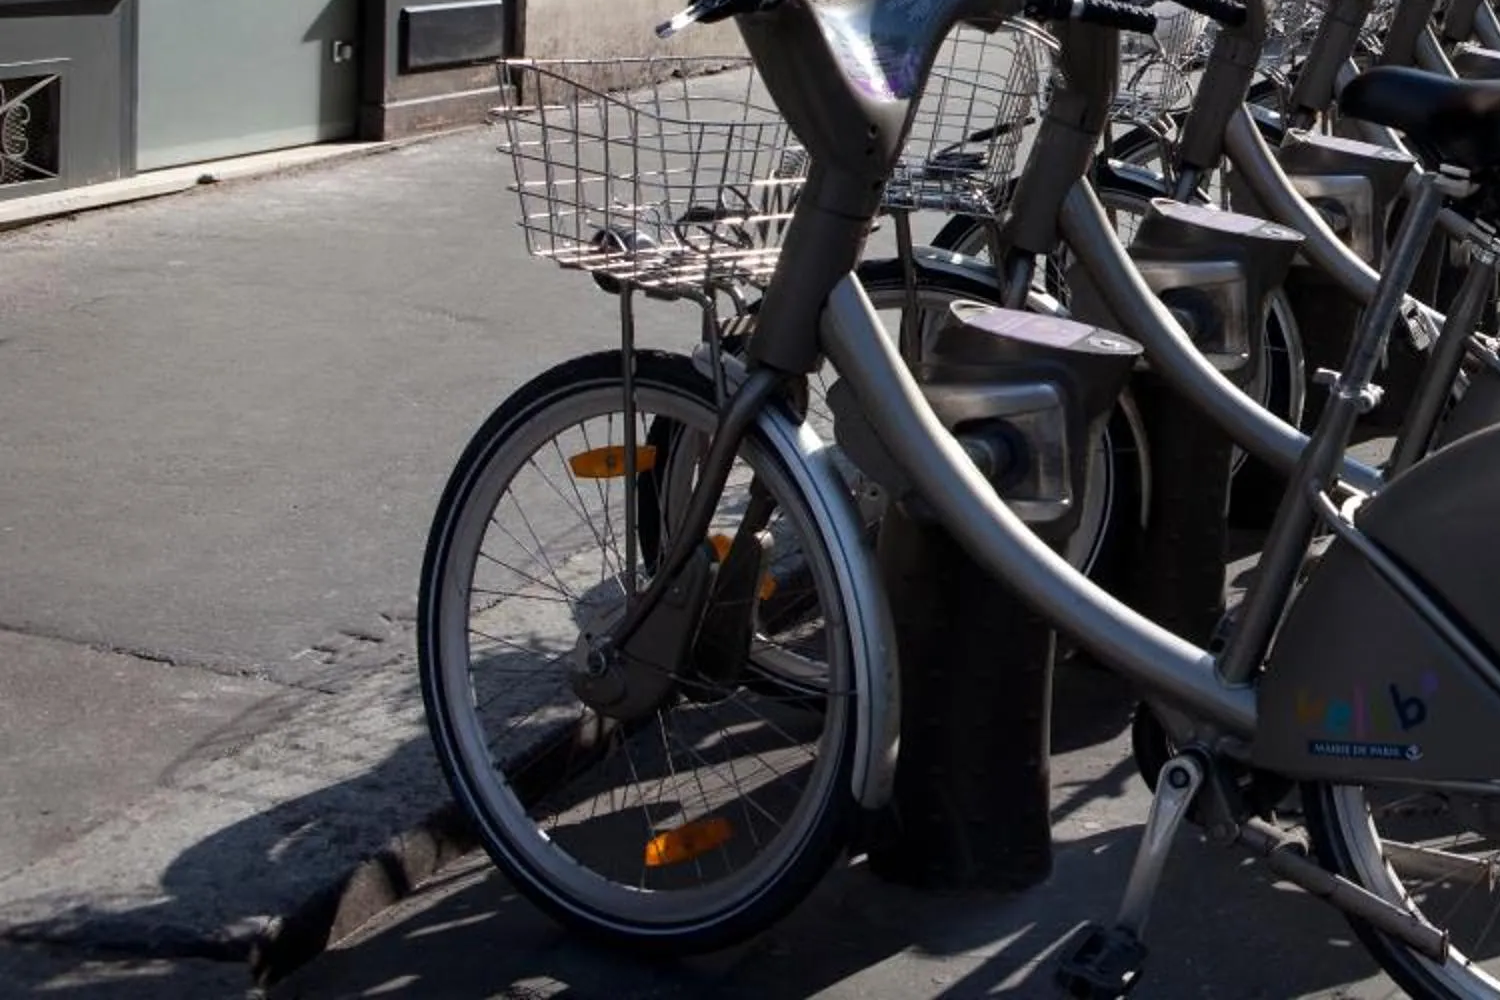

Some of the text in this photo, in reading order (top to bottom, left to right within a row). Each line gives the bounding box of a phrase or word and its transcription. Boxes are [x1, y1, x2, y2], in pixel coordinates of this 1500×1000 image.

[1313, 742, 1402, 758] MAIRIE DE PARIS
